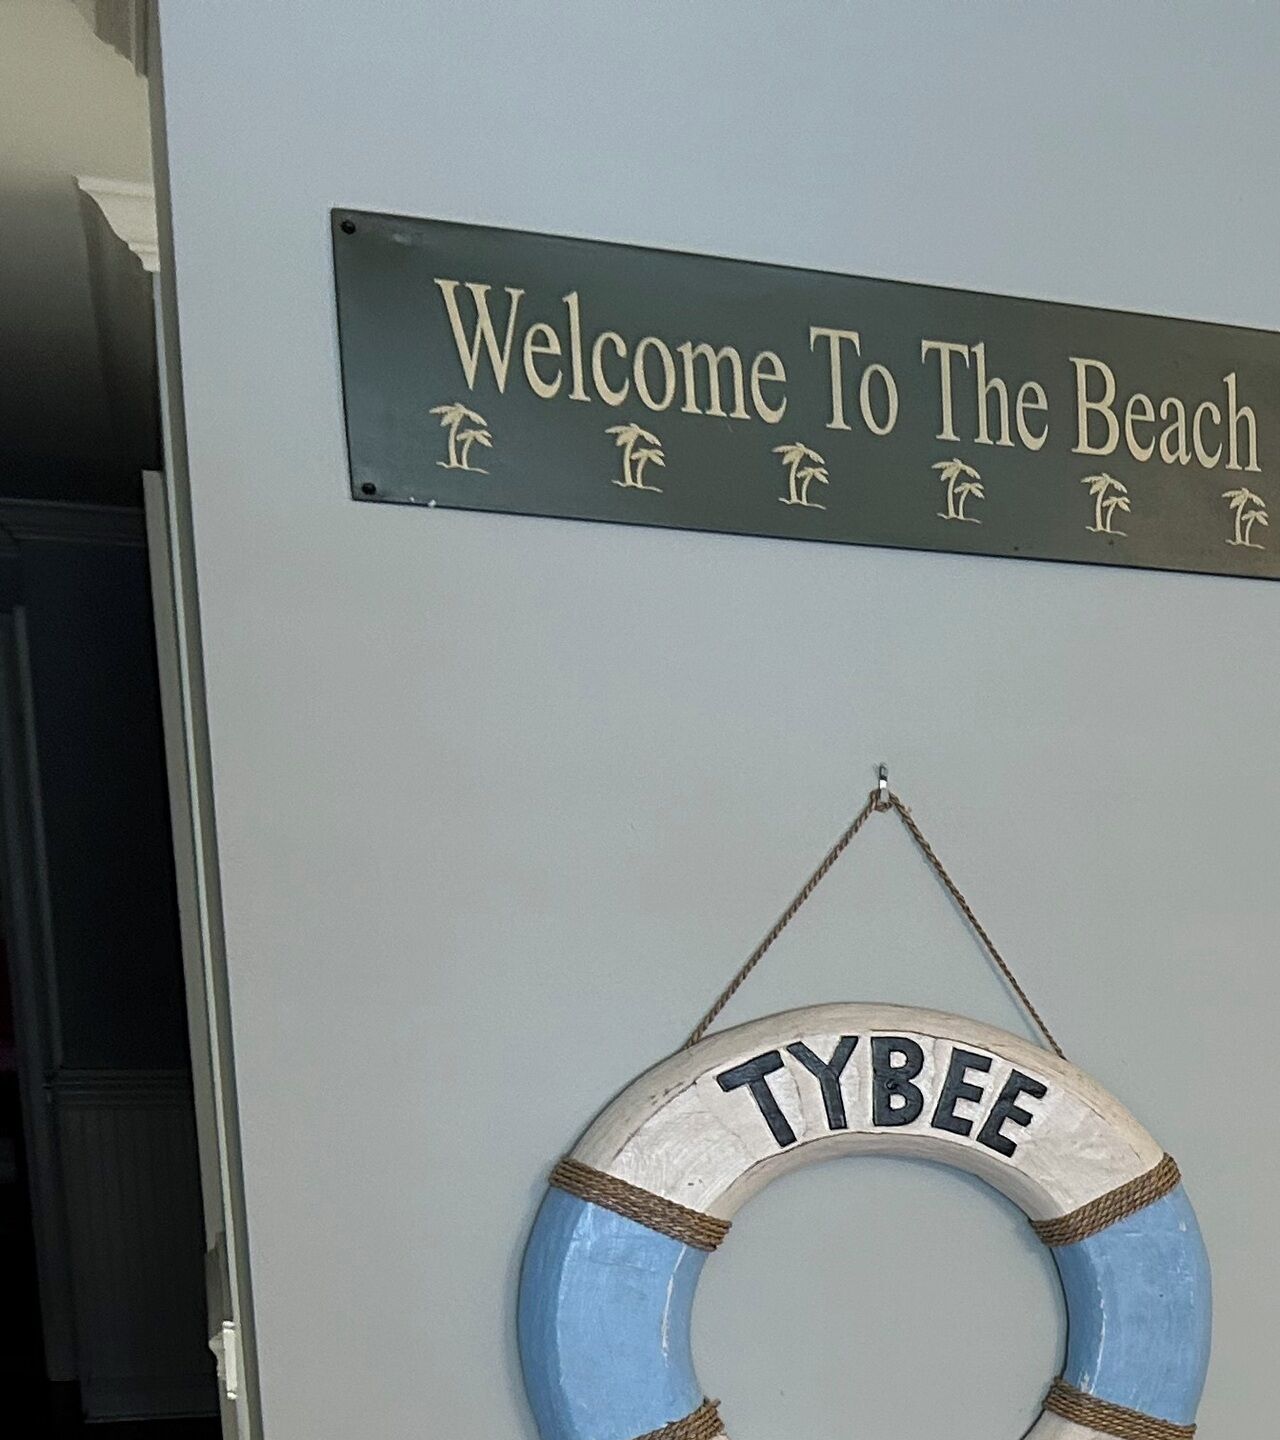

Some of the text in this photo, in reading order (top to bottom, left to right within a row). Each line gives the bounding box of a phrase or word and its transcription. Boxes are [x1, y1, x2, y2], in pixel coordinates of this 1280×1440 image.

[434, 277, 1262, 474] Welcome To The Beach
[715, 1035, 1048, 1158] TYBEE
